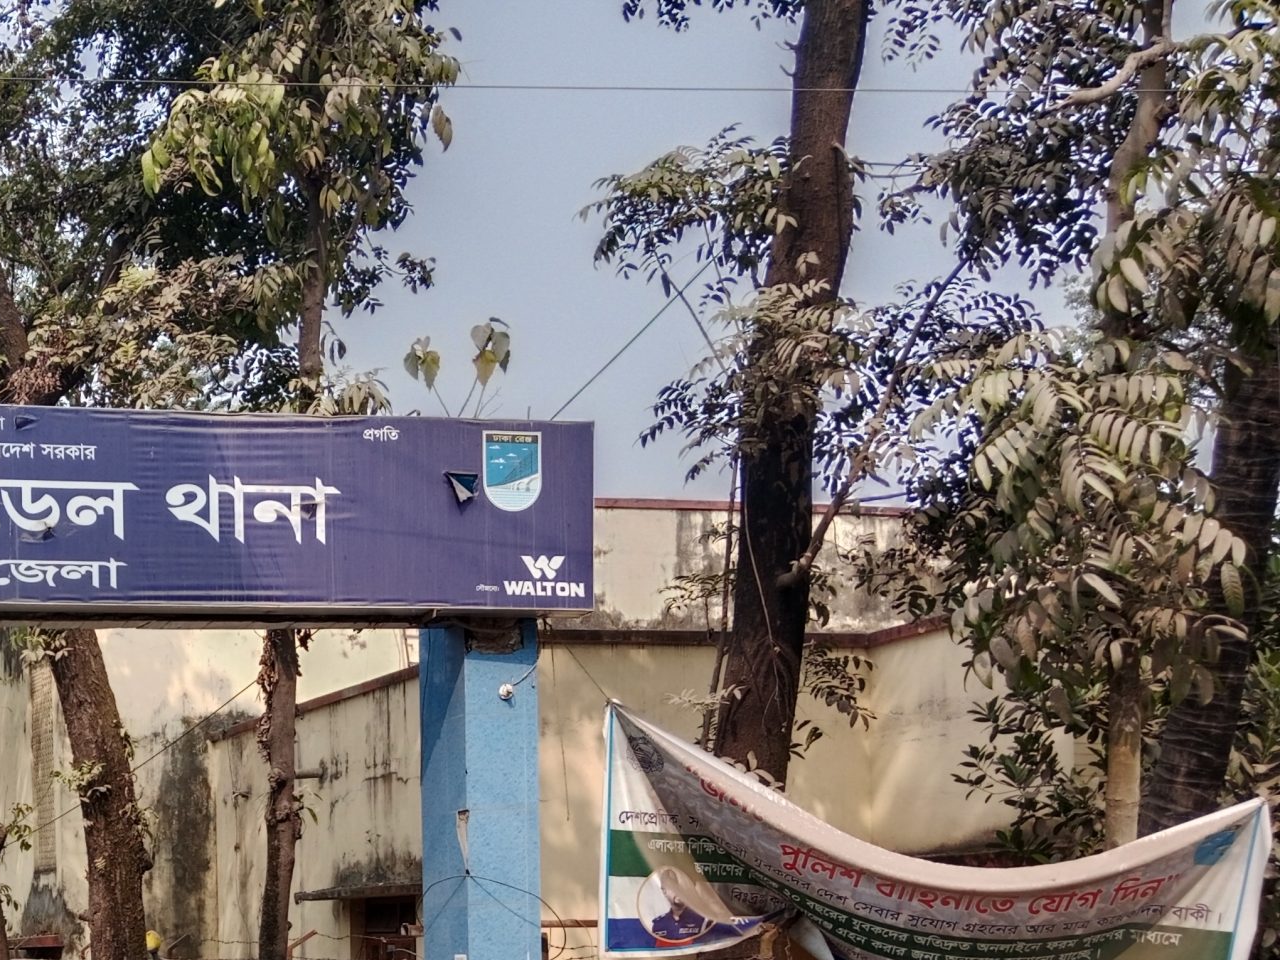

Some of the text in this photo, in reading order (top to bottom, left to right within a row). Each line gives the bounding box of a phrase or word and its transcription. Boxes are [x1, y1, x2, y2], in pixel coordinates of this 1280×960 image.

[363, 426, 400, 442] প্রগতি
[40, 443, 97, 461] সরকার
[167, 474, 342, 544] থানা
[503, 580, 585, 597] WALTON
[780, 843, 865, 888] পুলিশ
[1028, 888, 1102, 915] যোগ
[817, 886, 848, 905] দেশ
[854, 899, 900, 921] সেবার
[907, 913, 958, 932] সুযোগ
[1025, 923, 1055, 934] আর
[1062, 919, 1089, 931] মাত্র
[1171, 903, 1213, 923] বাকী
[851, 918, 907, 943] যুবকদের
[975, 940, 1040, 954] অনলাইনে
[1046, 940, 1077, 951] ফরম
[1130, 929, 1182, 946] মাধ্যমে
[871, 939, 908, 957] করার
